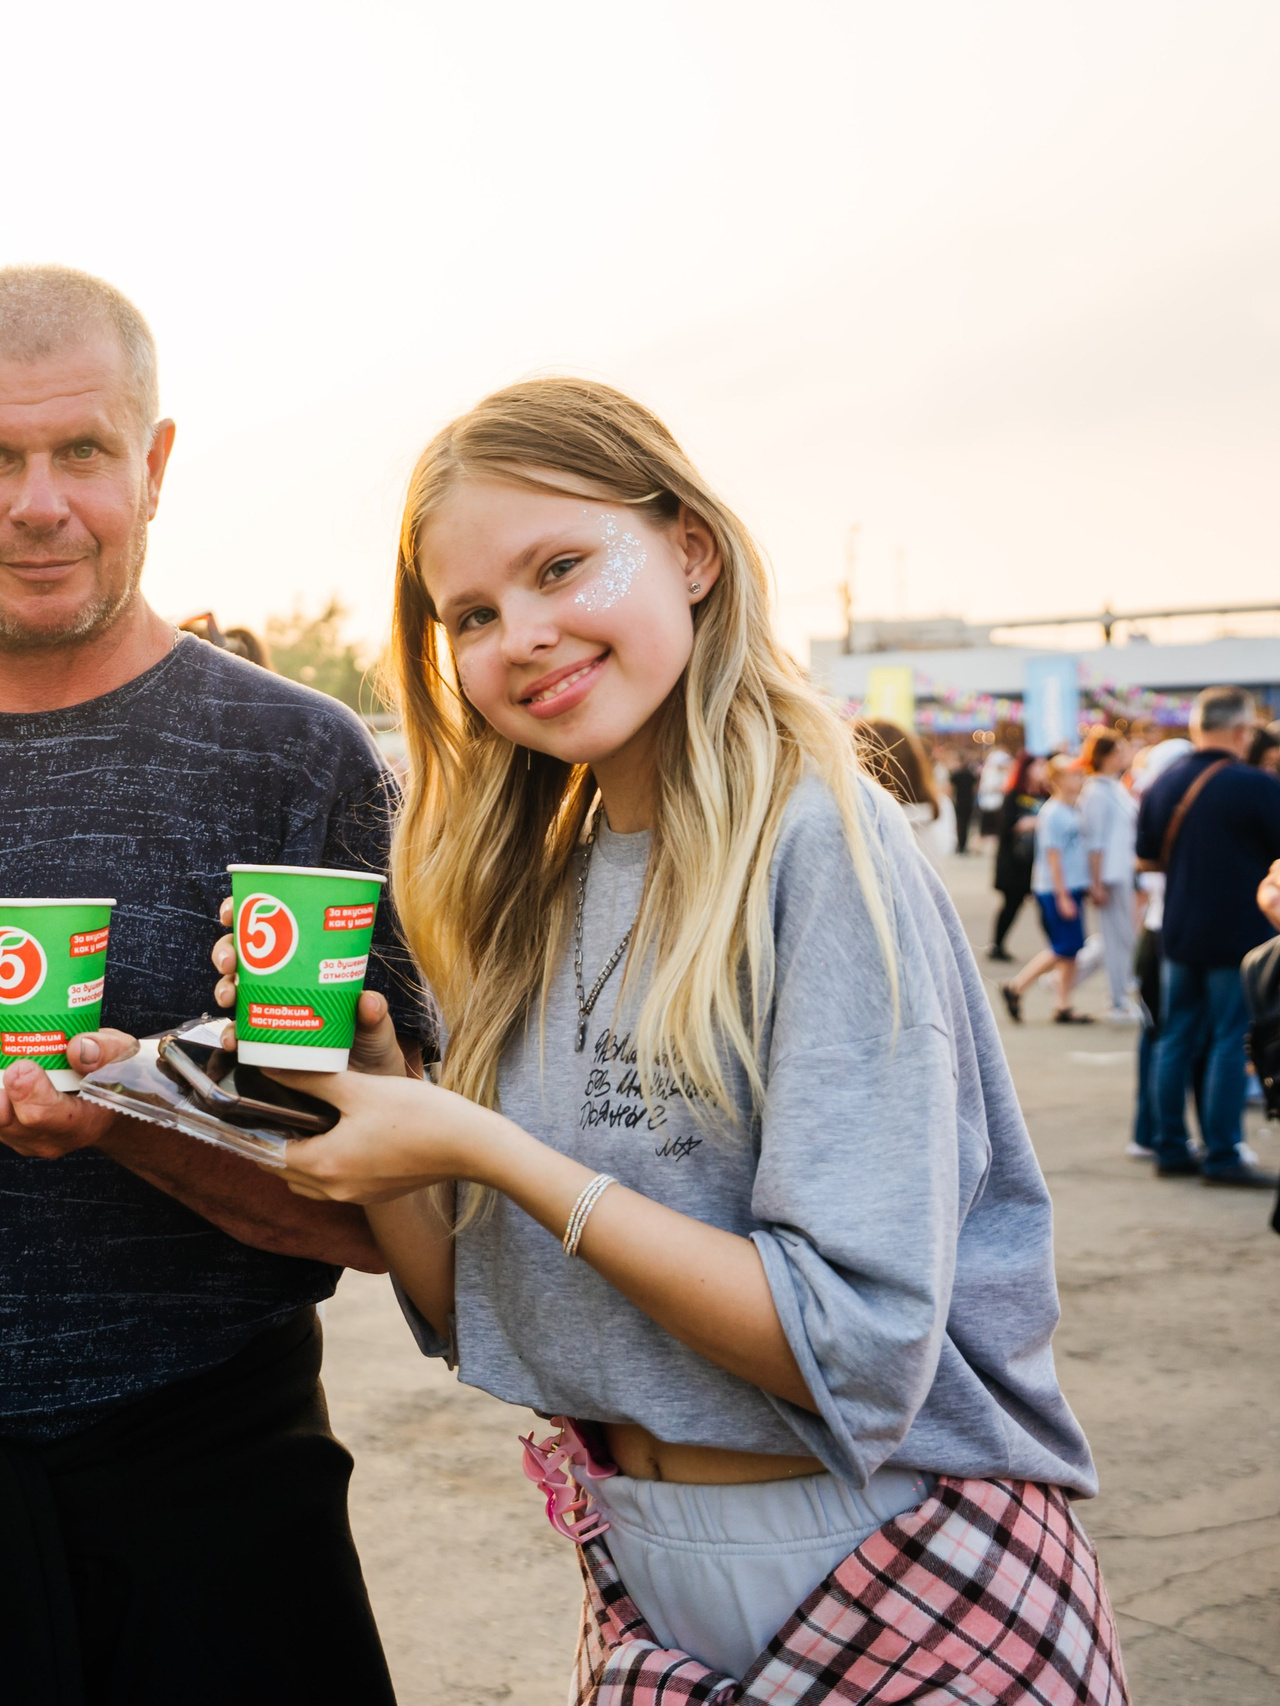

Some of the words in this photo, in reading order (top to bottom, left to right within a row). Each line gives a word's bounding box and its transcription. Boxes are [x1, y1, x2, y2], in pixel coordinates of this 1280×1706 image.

[329, 908, 341, 917] За
[328, 920, 346, 928] как
[246, 899, 279, 960] 5
[74, 935, 84, 944] За
[74, 945, 89, 953] как
[323, 961, 334, 969] За
[72, 986, 81, 994] За
[252, 1004, 262, 1014] За
[263, 1006, 309, 1016] сладким
[251, 1017, 319, 1028] настроением
[5, 1033, 16, 1042] За
[17, 1033, 61, 1043] сладким
